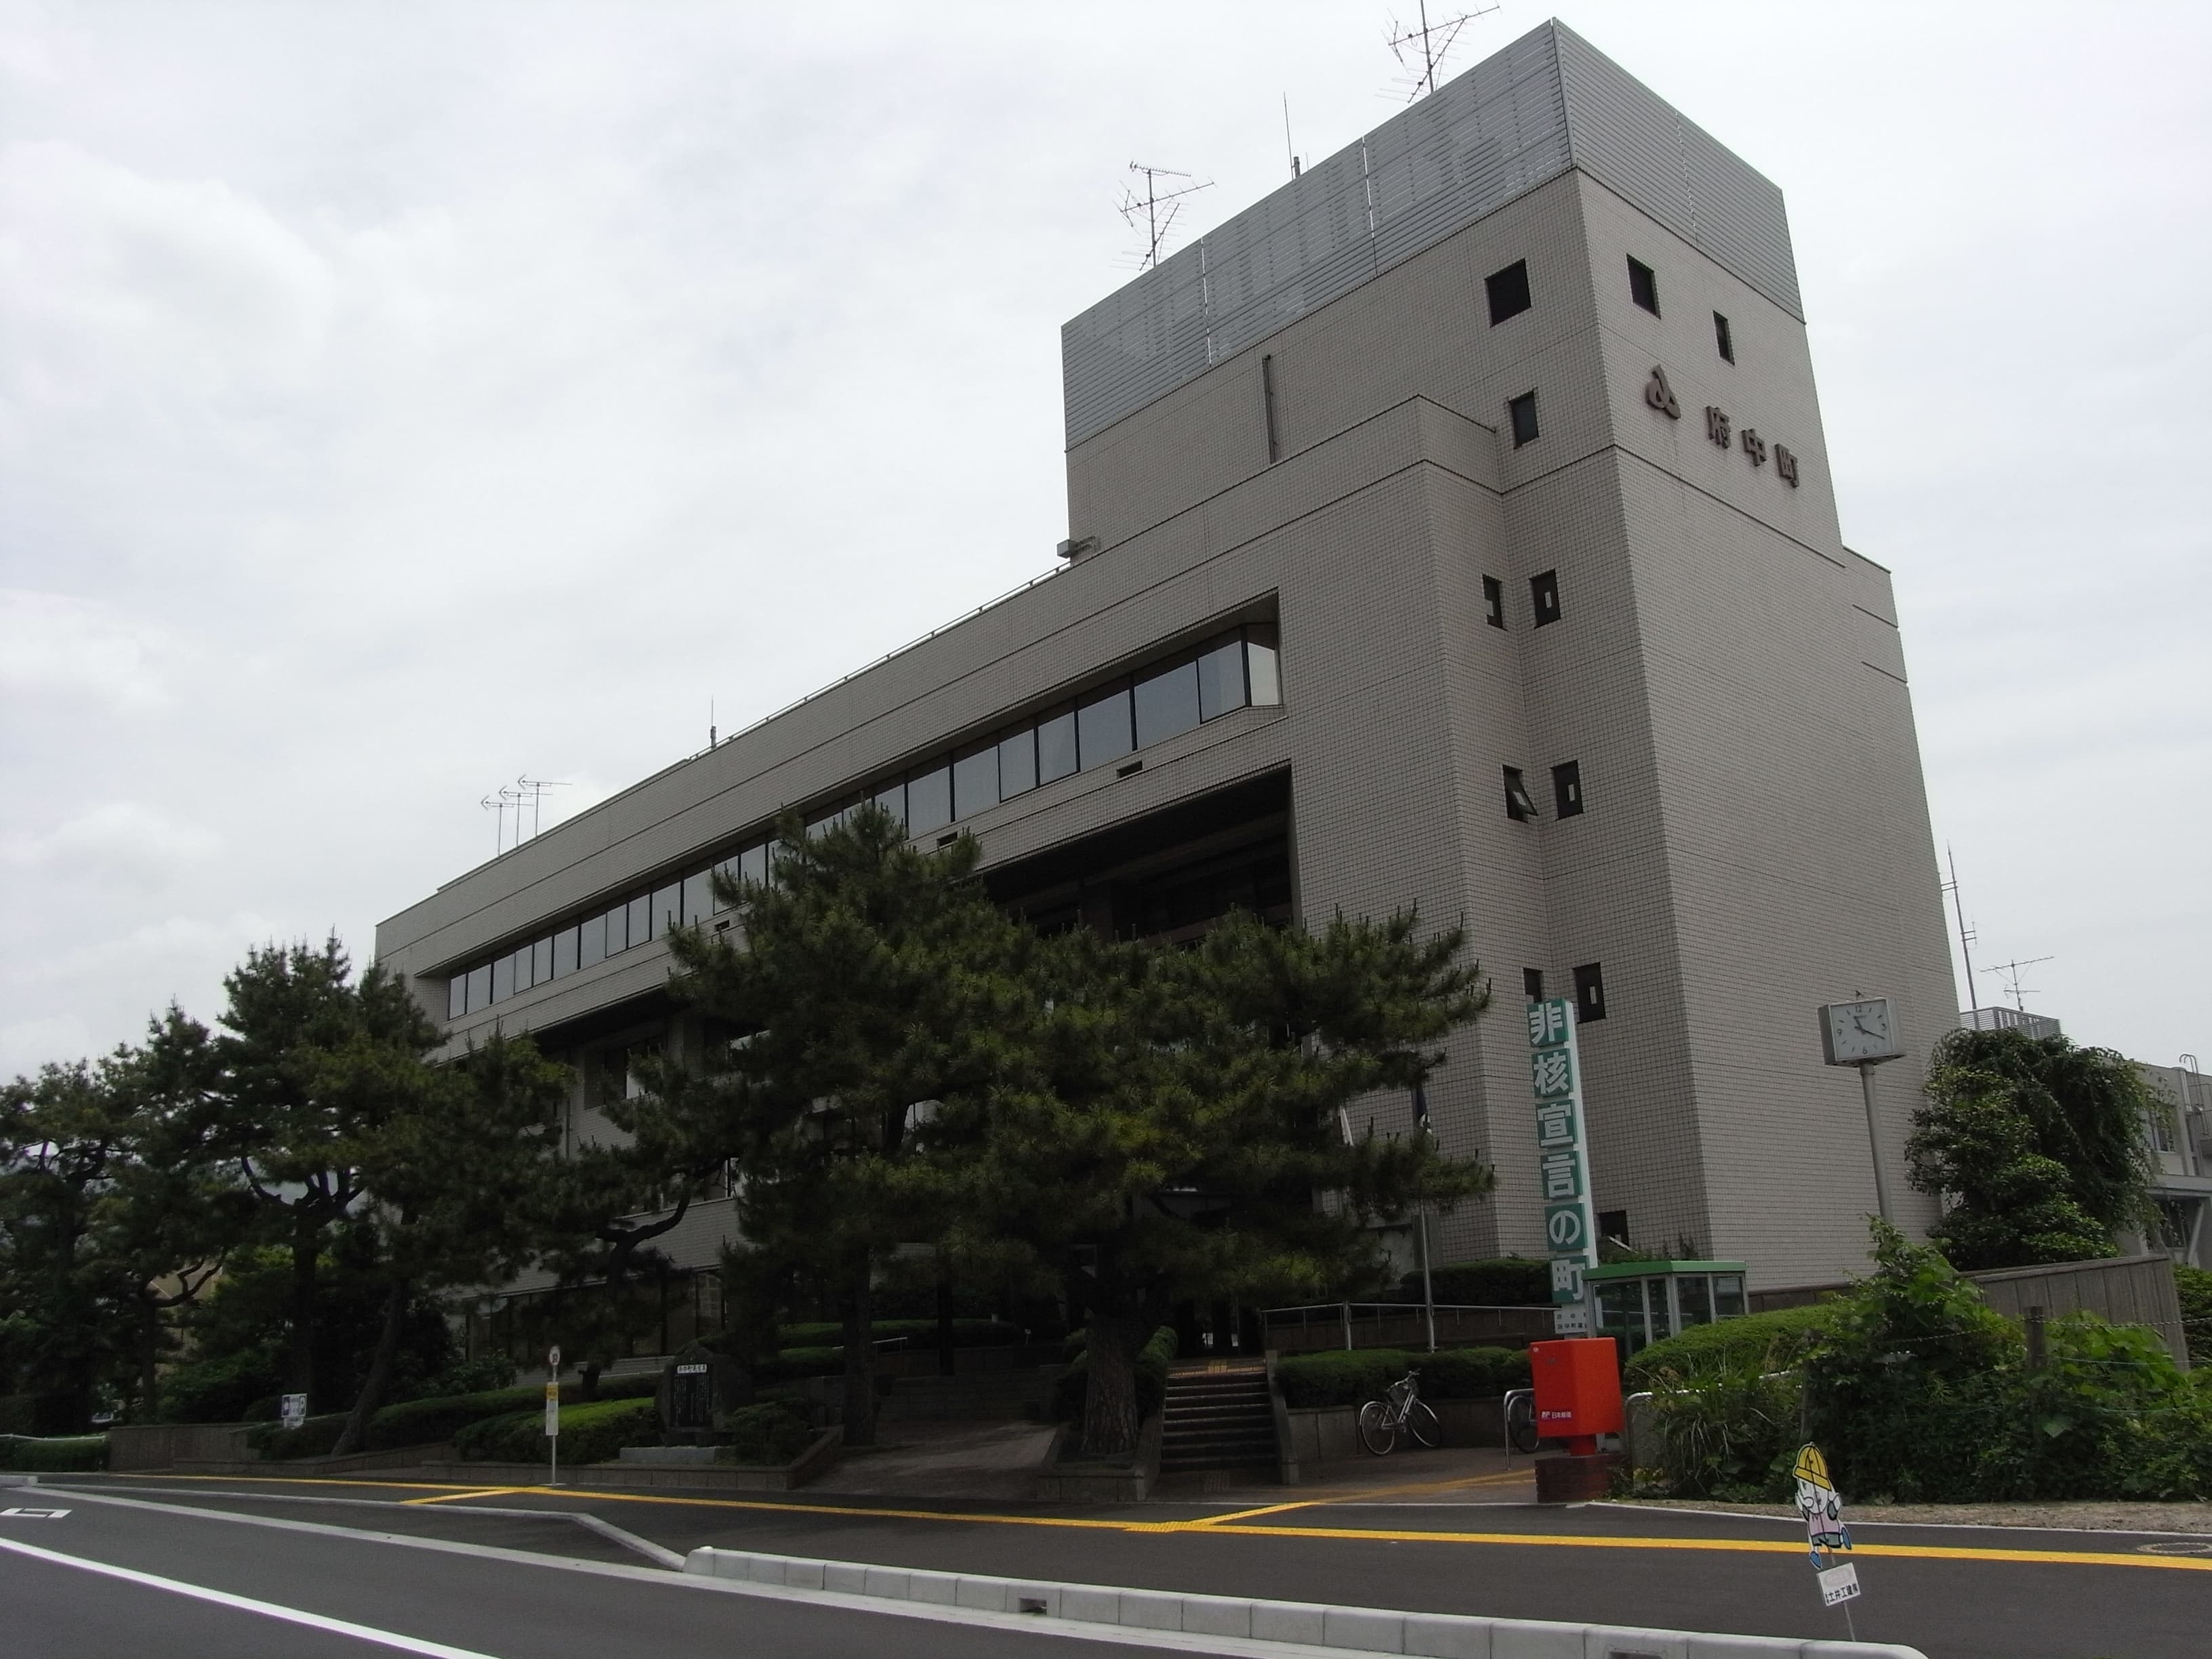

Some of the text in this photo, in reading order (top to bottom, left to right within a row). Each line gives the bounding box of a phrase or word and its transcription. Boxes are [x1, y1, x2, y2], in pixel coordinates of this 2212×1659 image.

[1706, 405, 1800, 489] 府中町
[1862, 1046, 1868, 1054] 6
[1528, 998, 1585, 1300] 非核宣言の町
